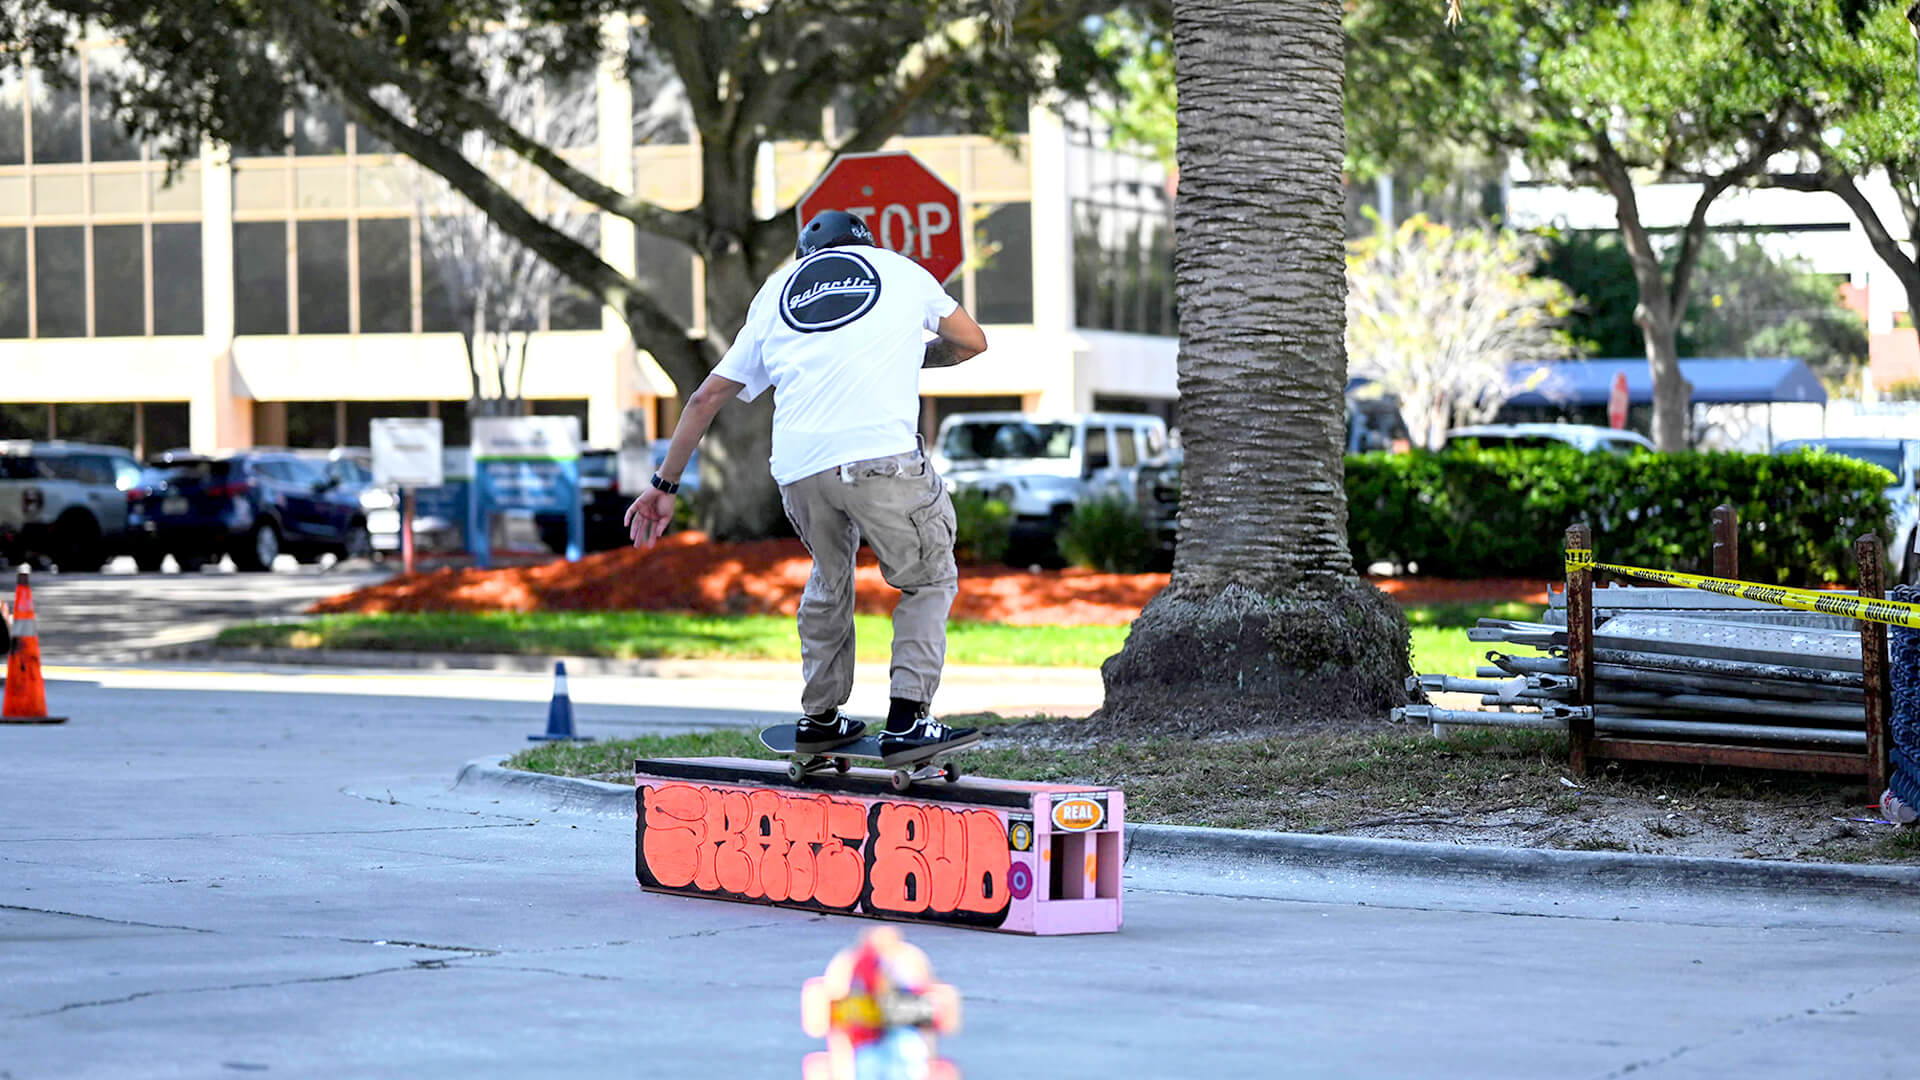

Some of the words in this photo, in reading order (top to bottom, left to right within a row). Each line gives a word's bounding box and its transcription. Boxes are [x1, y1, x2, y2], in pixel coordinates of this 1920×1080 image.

[789, 277, 871, 309] galactic
[1814, 594, 1860, 618] CAUTION
[1864, 601, 1911, 625] CAUTION
[1063, 805, 1093, 820] REAL
[643, 784, 867, 908] SKATE
[870, 802, 1012, 914] BUD
